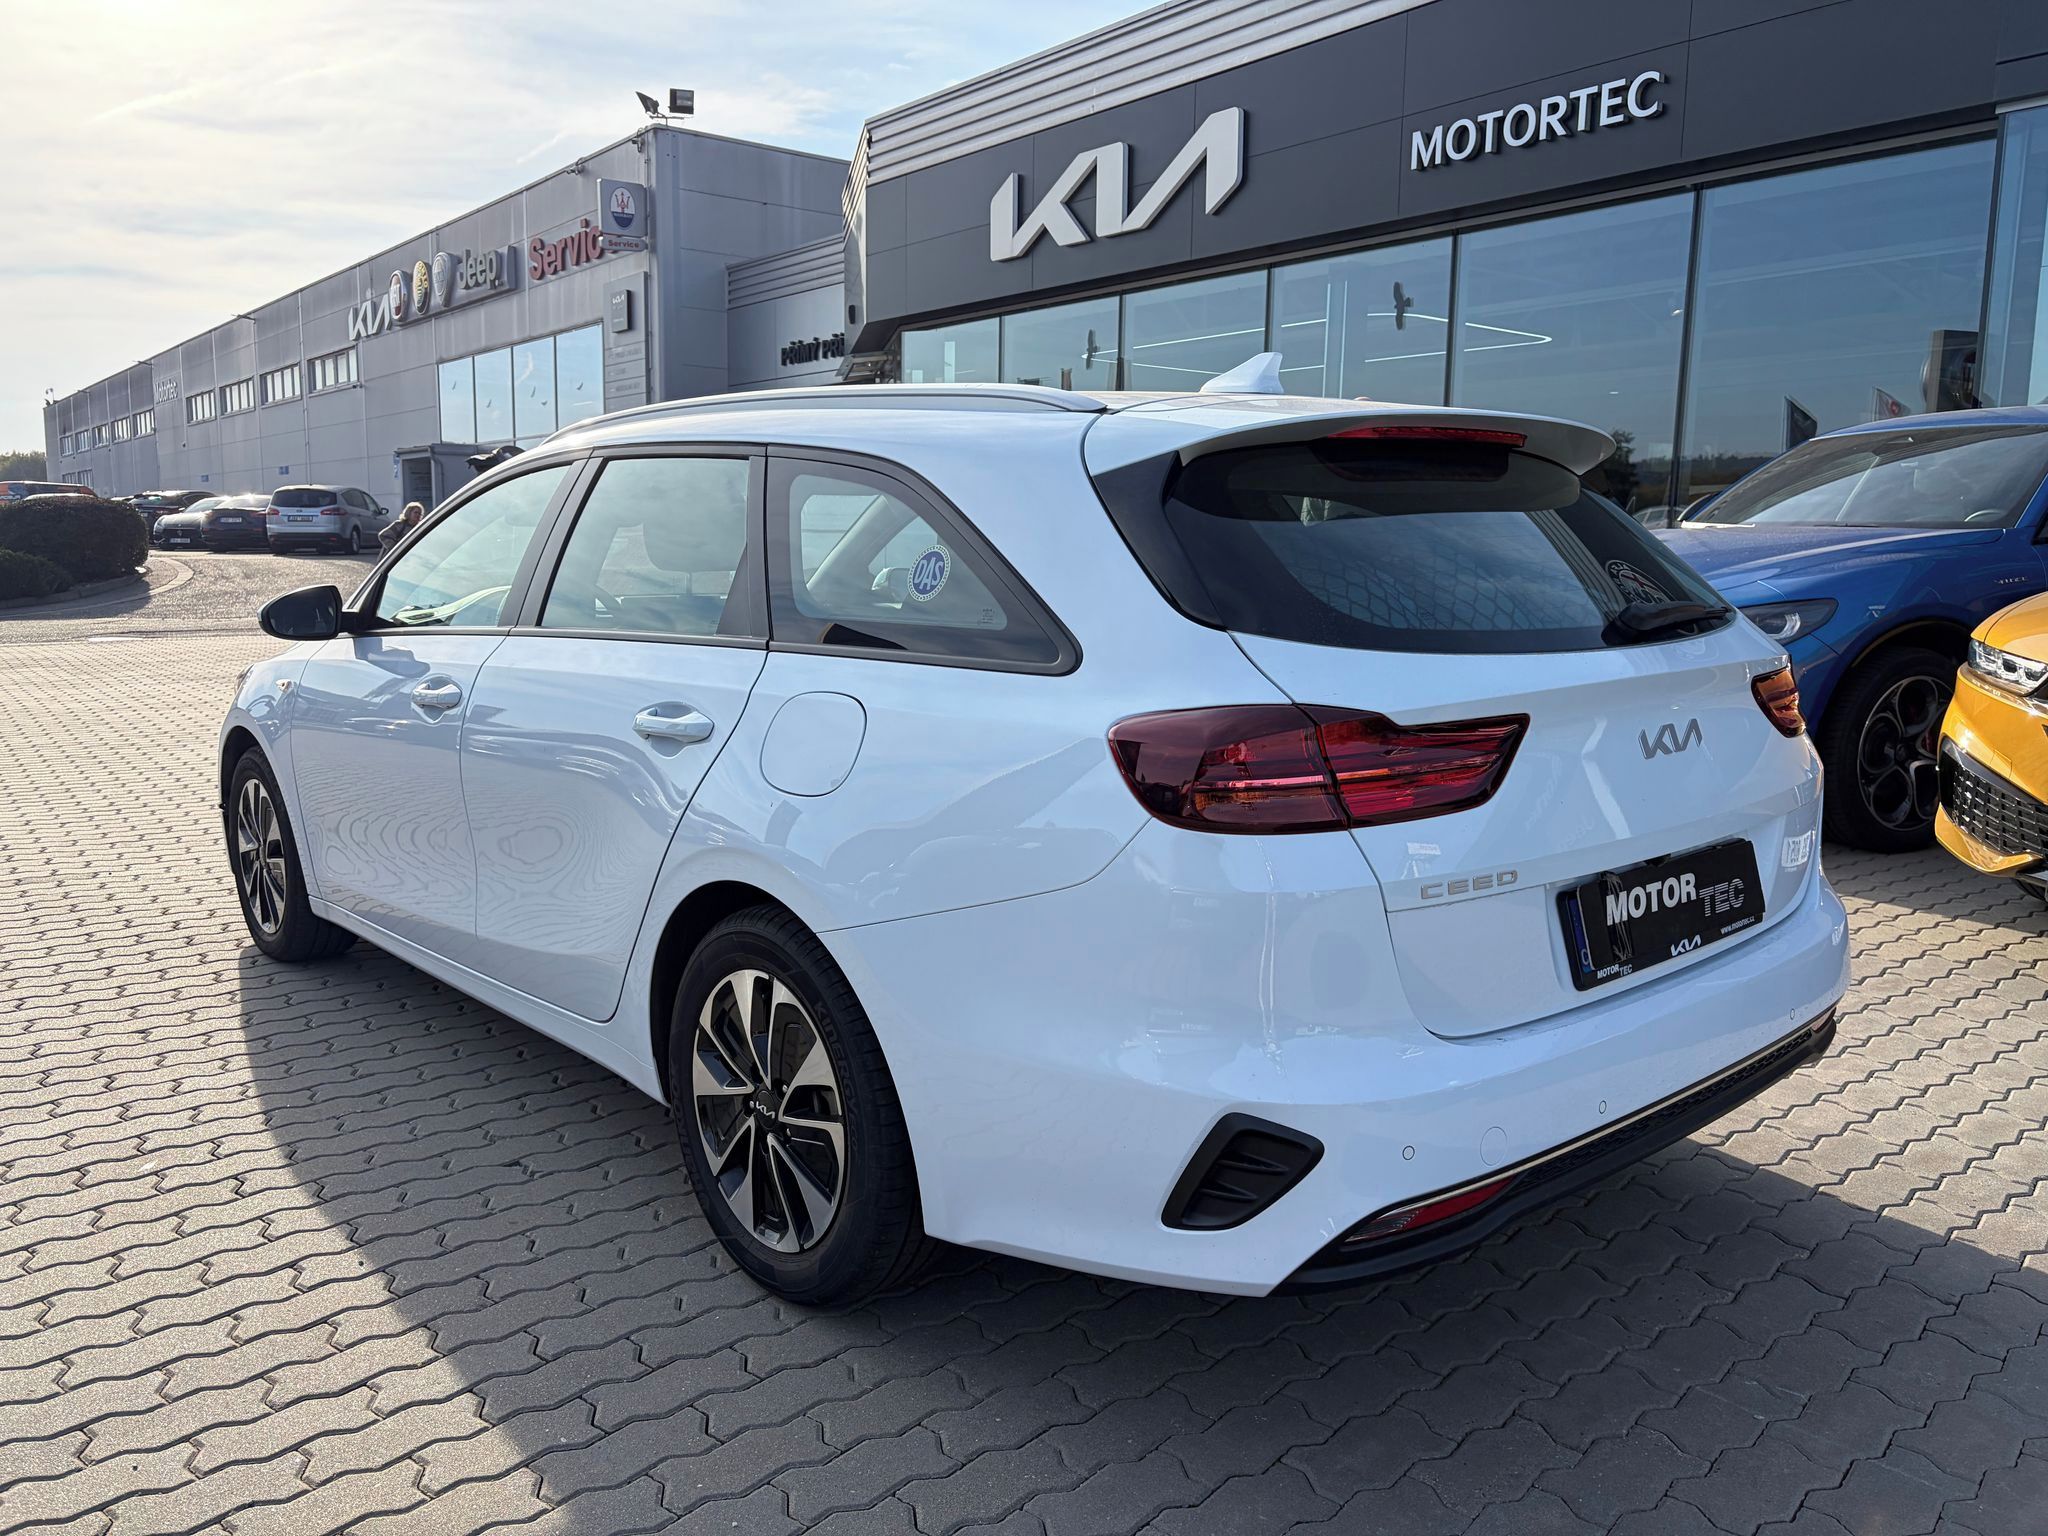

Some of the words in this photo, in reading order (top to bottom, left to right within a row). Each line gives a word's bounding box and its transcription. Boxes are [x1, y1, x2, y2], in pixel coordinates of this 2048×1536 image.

[1410, 70, 1663, 170] MOTORTEC
[990, 106, 1244, 262] KIA
[529, 218, 614, 281] Servic
[348, 293, 391, 341] KIA
[1638, 718, 1703, 760] KIA
[1421, 869, 1518, 899] CEED
[1670, 934, 1701, 956] KIA
[755, 1101, 775, 1119] KIA
